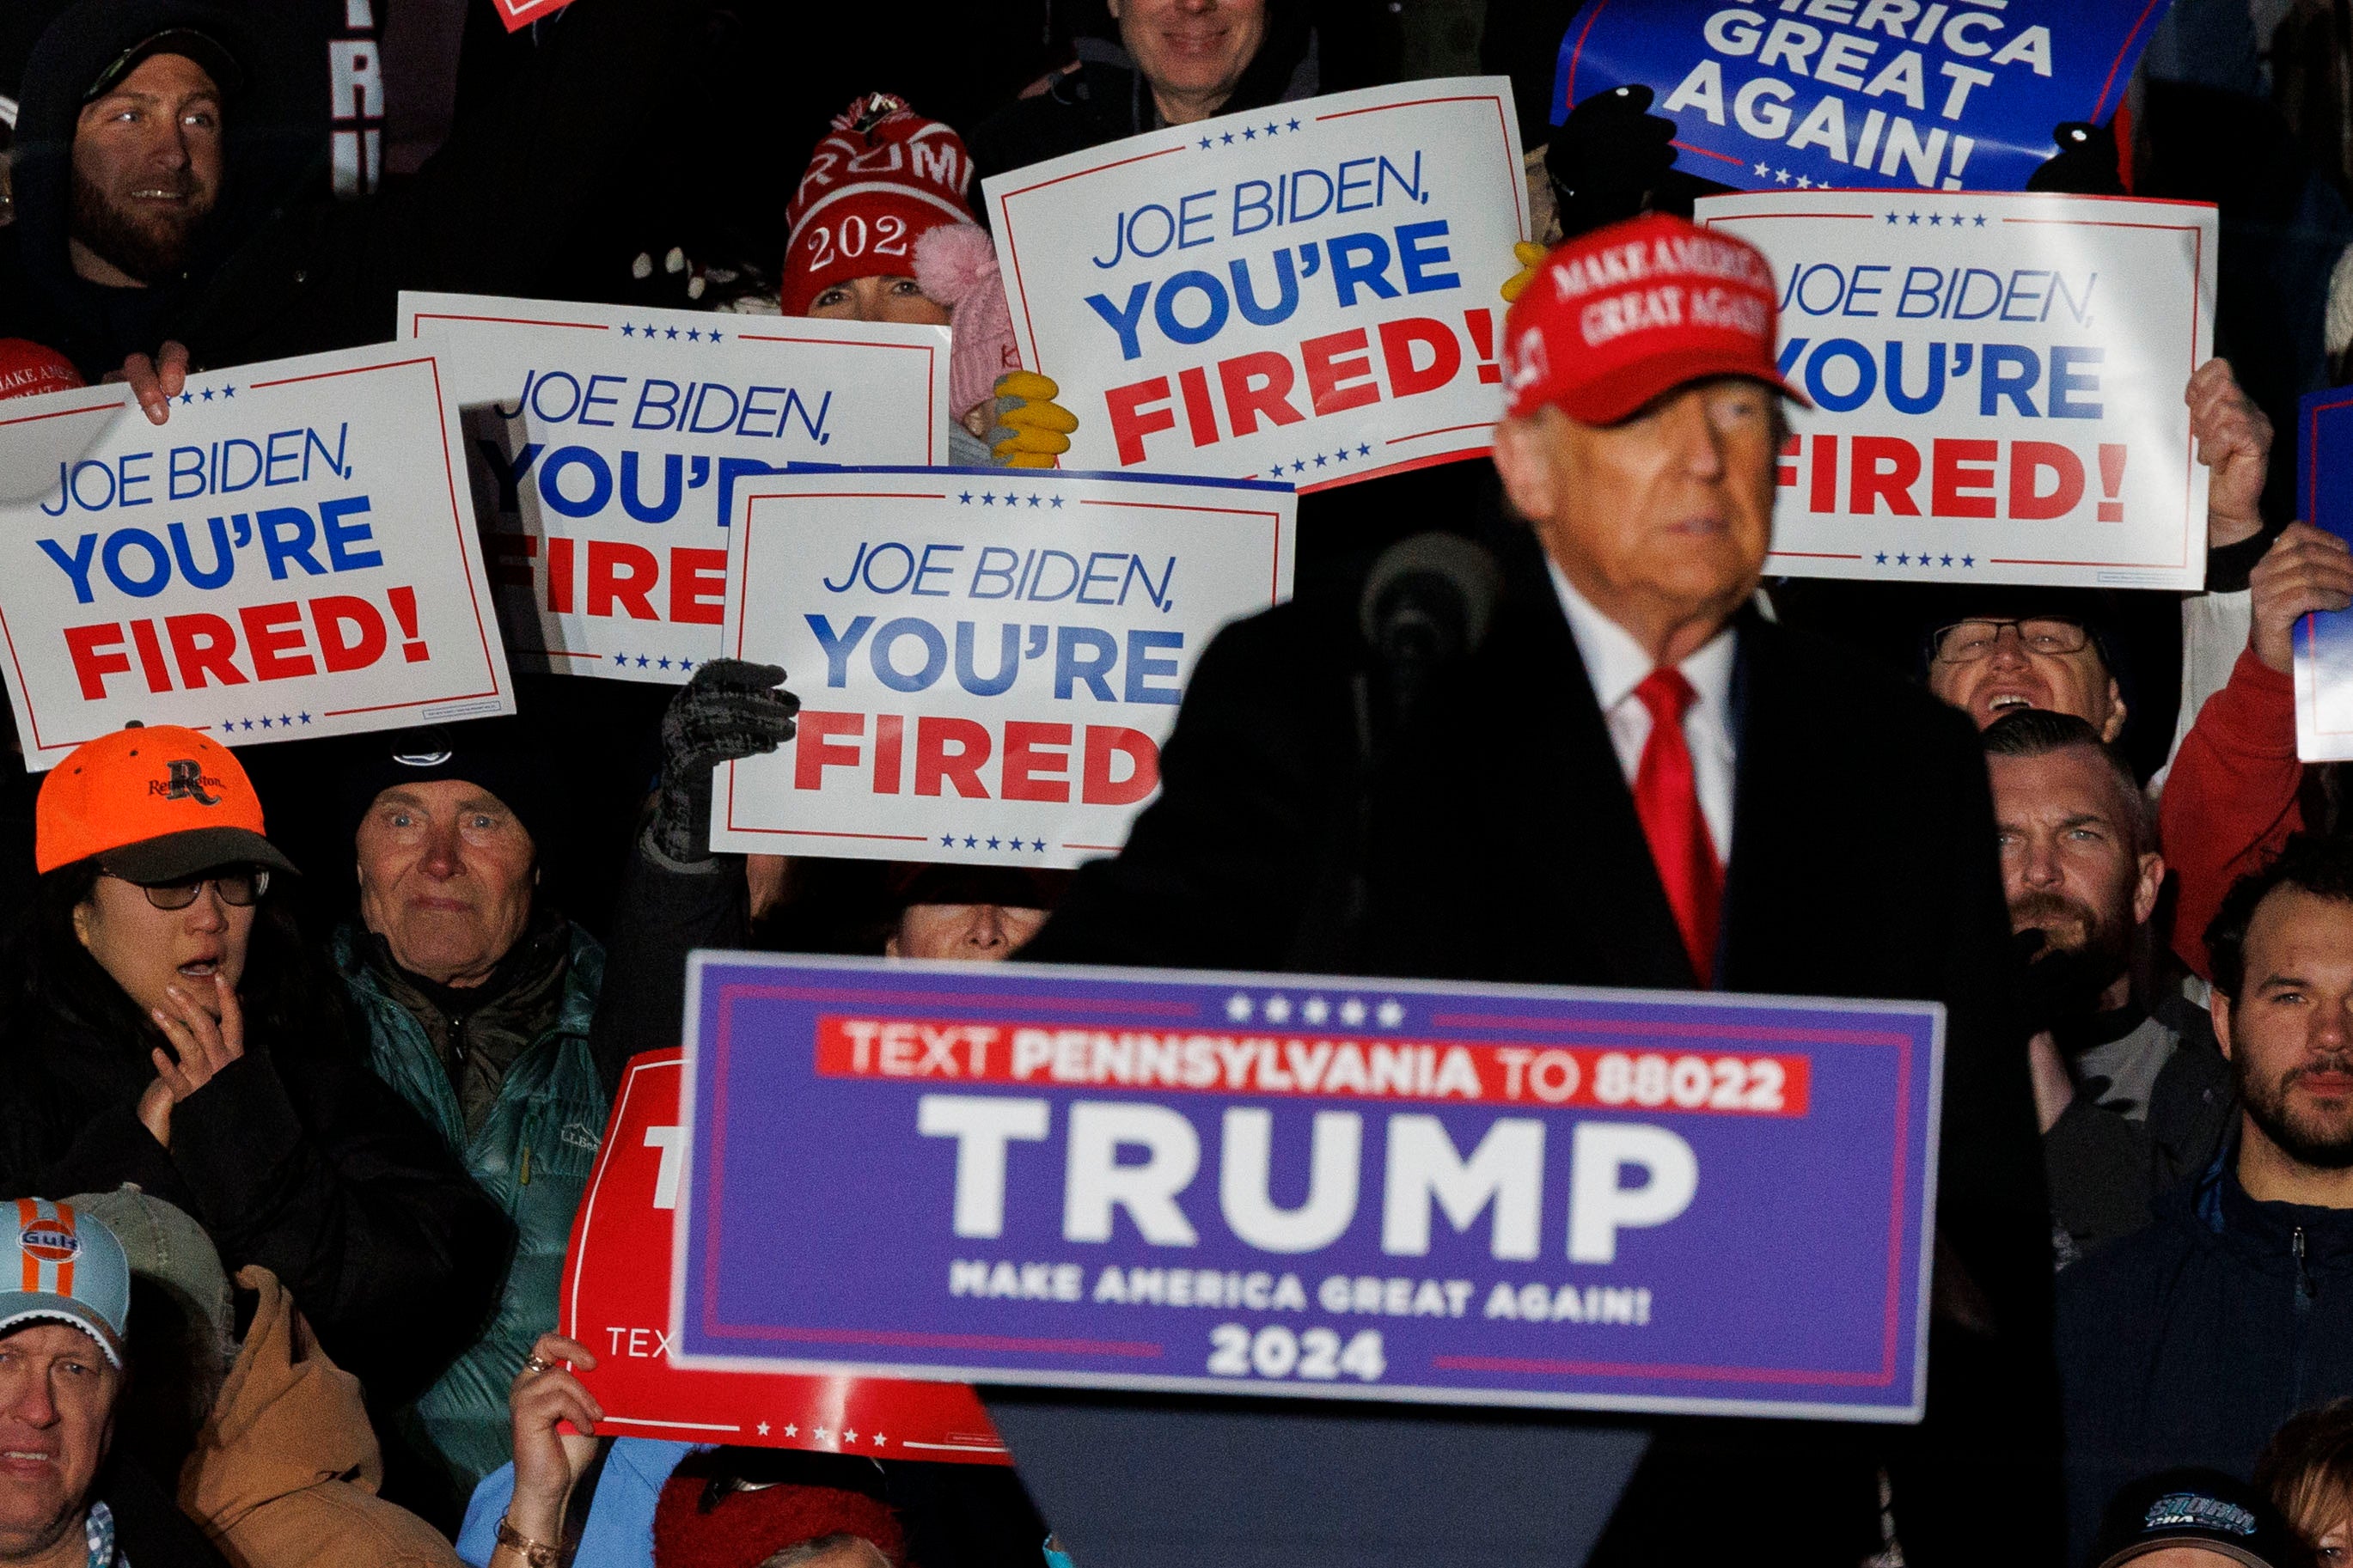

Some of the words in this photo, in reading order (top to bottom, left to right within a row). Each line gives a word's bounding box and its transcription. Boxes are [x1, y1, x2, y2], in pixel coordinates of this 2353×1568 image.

[1703, 9, 1995, 120] GREAT
[1663, 59, 1975, 191] AGAIN!
[1093, 189, 1217, 269] JOE
[1232, 150, 1429, 237] BIDEN,
[1085, 219, 1461, 361] YOU'RE
[1776, 262, 1892, 317] JOE
[1896, 267, 2099, 329] BIDEN,
[496, 369, 627, 428] JOE
[633, 380, 832, 446] BIDEN,
[1104, 308, 1502, 467] FIRED!
[40, 452, 154, 516] JOE
[168, 422, 352, 501] BIDEN,
[36, 496, 384, 604] YOU'RE
[823, 541, 964, 596] JOE
[969, 546, 1176, 613] BIDEN,
[64, 585, 431, 701] FIRED!
[804, 613, 1185, 705] YOU'RE
[845, 1021, 999, 1077] TEXT
[1011, 1031, 1482, 1101] PENNSYLVANIA
[1496, 1046, 1581, 1106] TO
[1592, 1052, 1786, 1112] 88022
[916, 1093, 1699, 1264] TRUMP
[21, 1231, 79, 1250] Gulf
[948, 1260, 1084, 1303] MAKE
[1093, 1267, 1307, 1312] AMERICA
[1317, 1276, 1473, 1318] GREAT
[1484, 1283, 1652, 1326] AGAIN!
[1206, 1322, 1387, 1382] 2024
[2148, 1497, 2256, 1531] STORM
